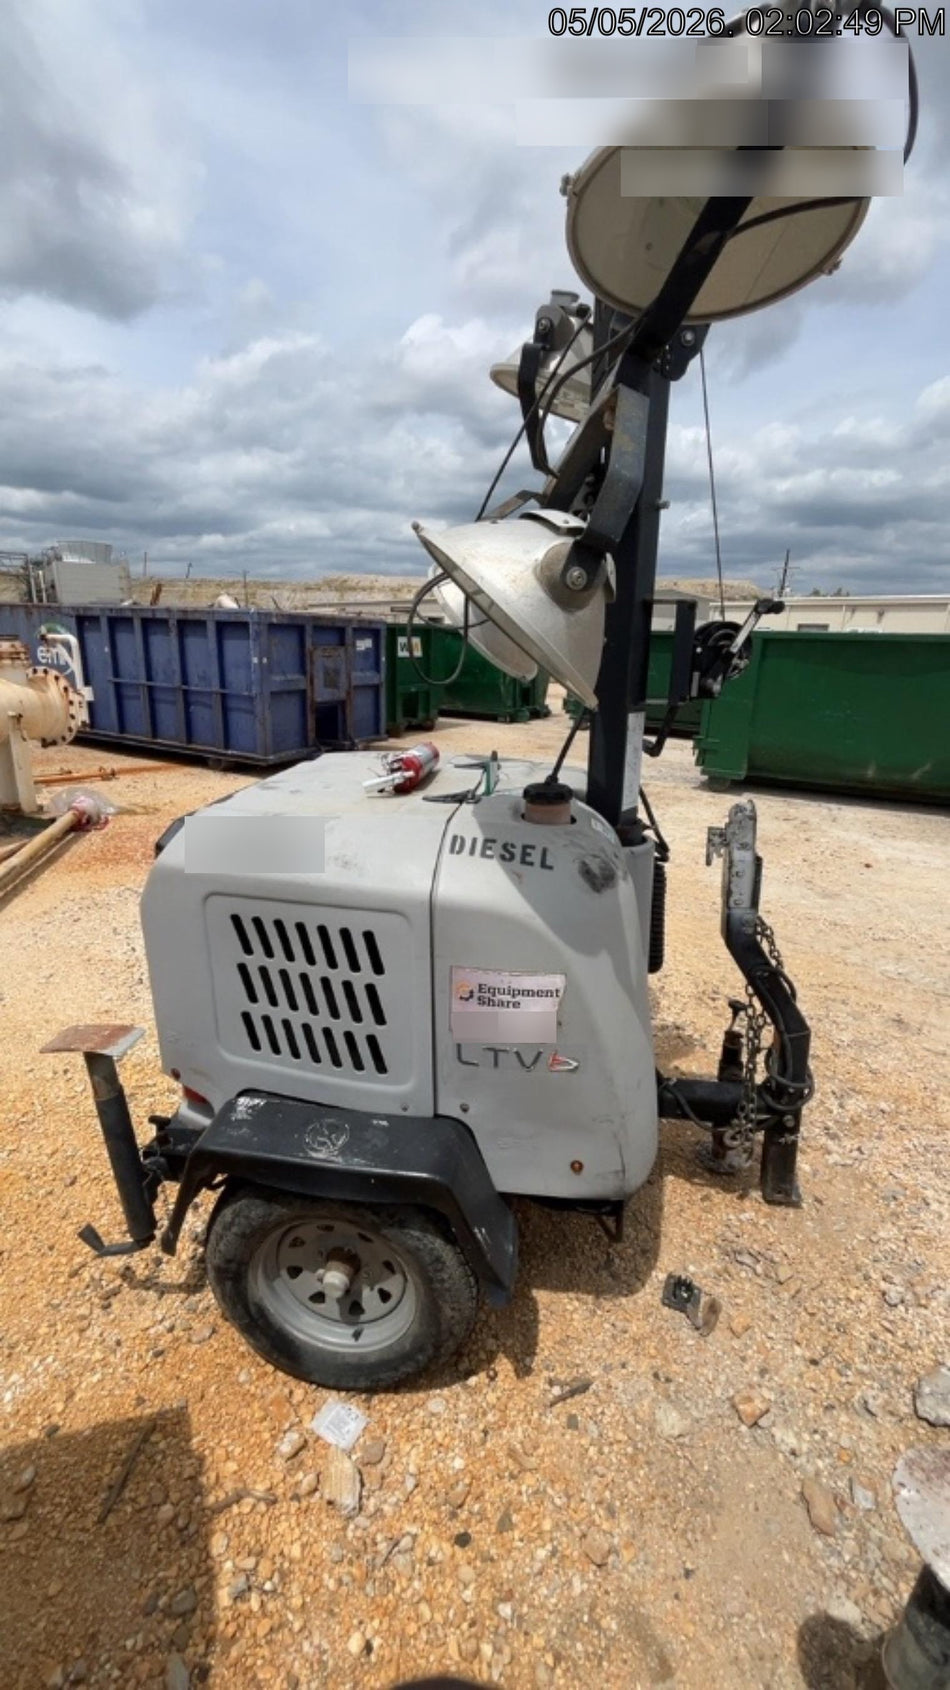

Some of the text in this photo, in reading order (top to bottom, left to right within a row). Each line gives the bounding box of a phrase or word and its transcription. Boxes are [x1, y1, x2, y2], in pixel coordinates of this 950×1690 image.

[449, 834, 554, 871] DIESEL
[477, 983, 561, 998] Equipment
[477, 996, 521, 1009] Share
